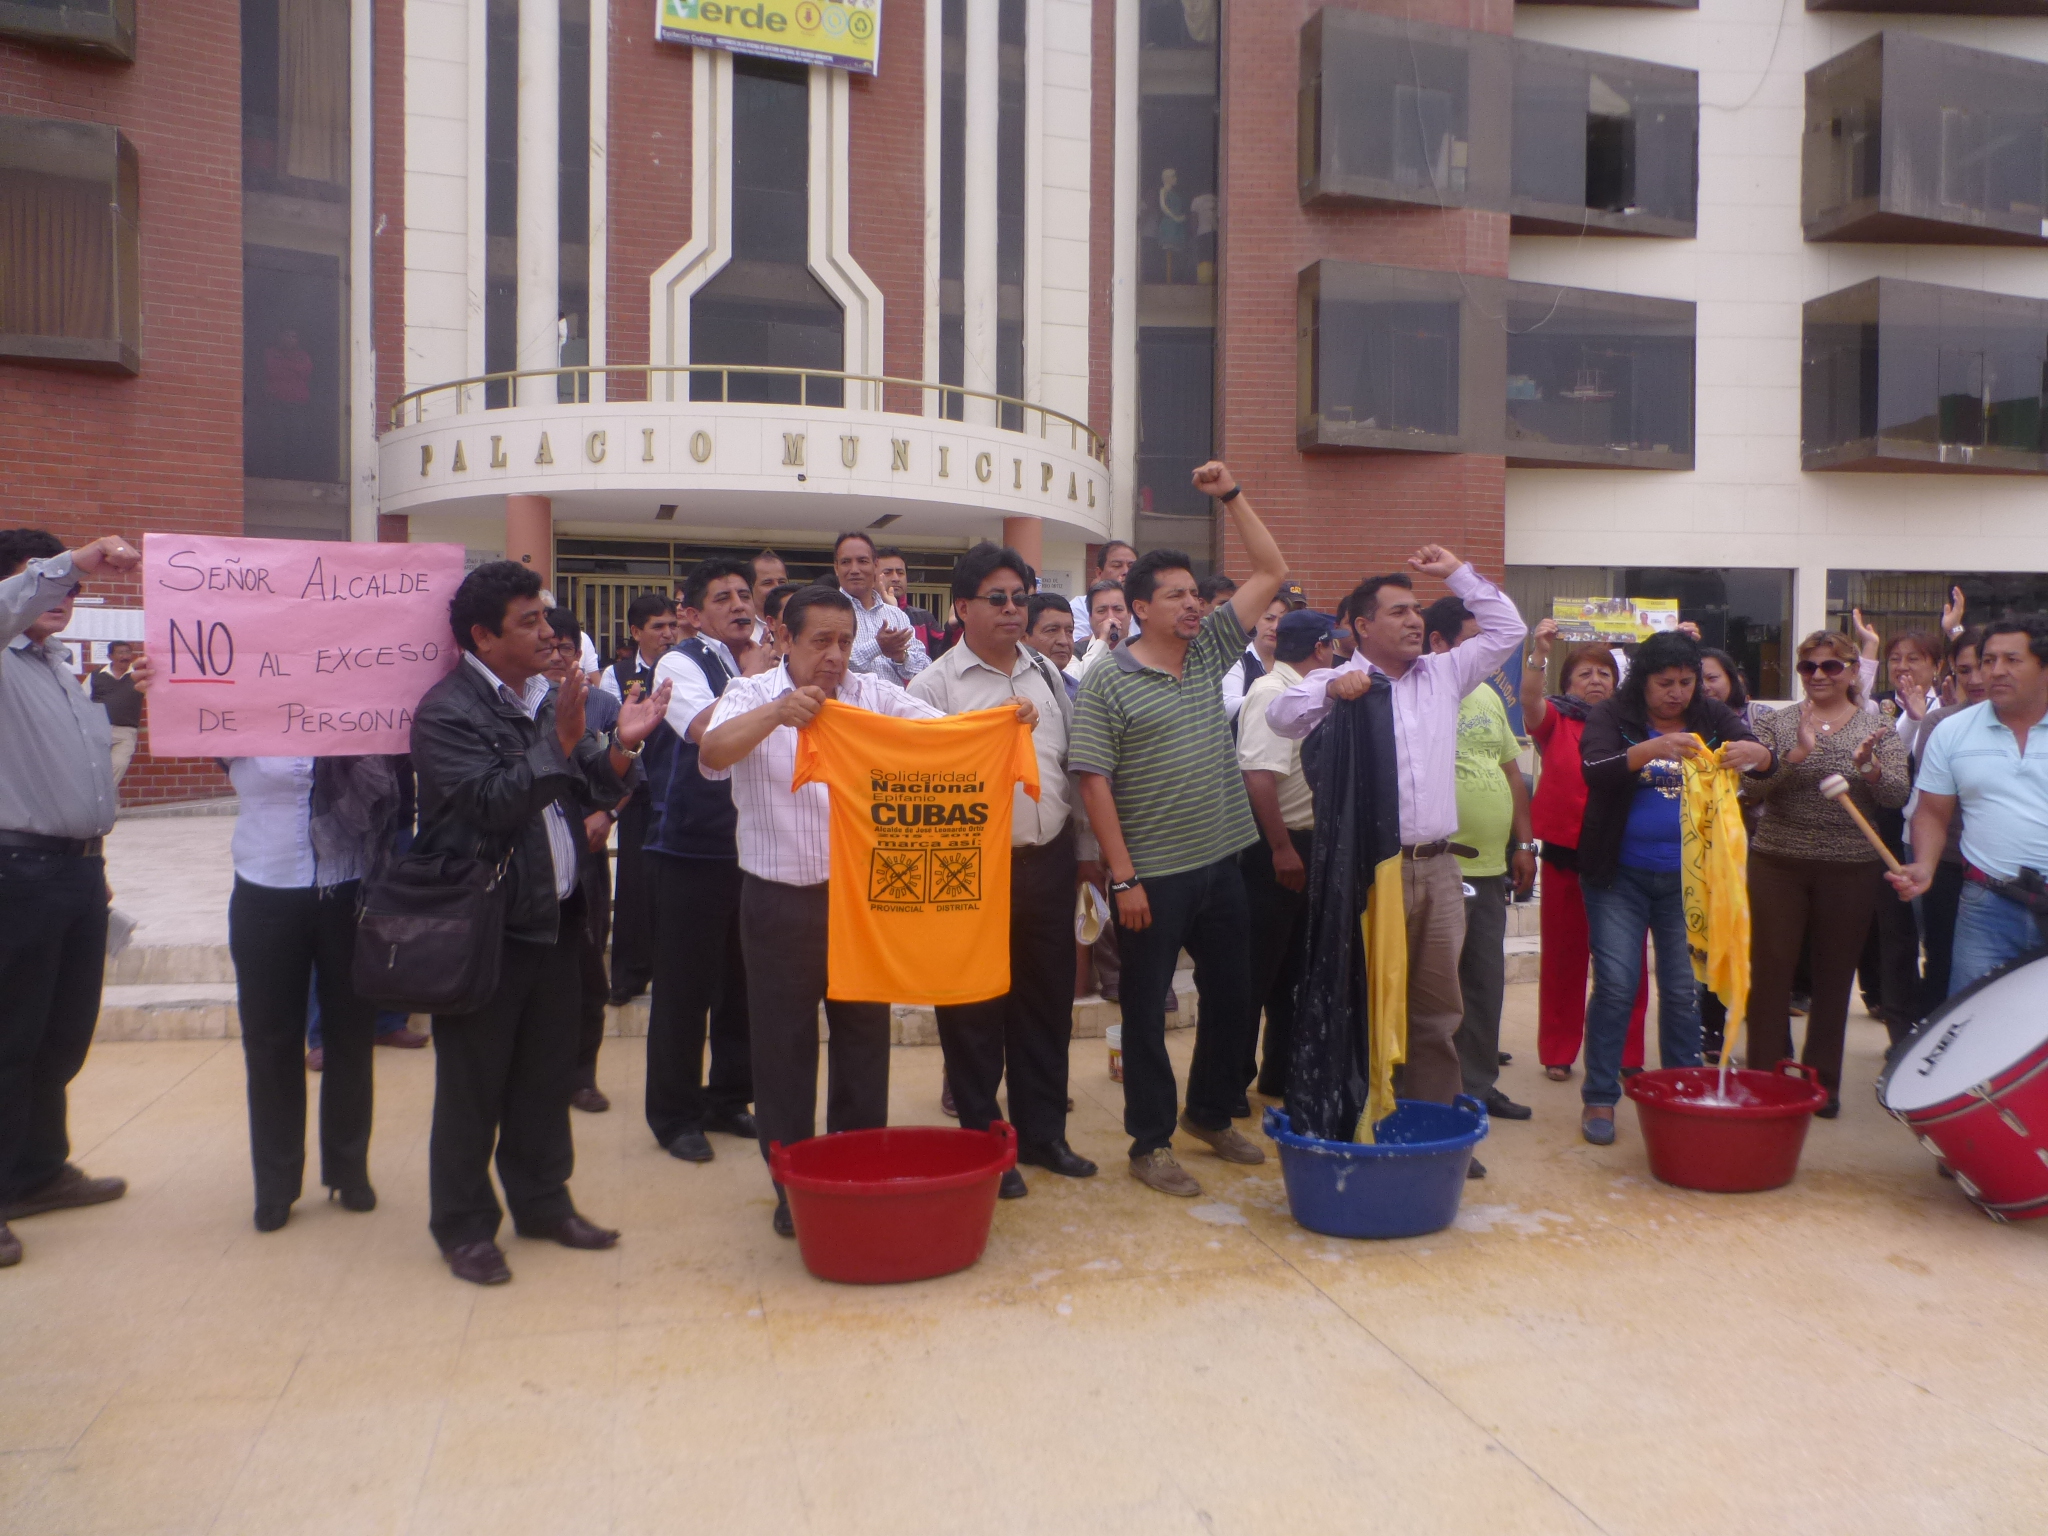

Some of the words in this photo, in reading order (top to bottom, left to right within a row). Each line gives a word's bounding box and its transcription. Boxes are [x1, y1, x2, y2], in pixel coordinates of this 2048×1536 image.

[420, 428, 713, 477] PALACIO
[782, 432, 1096, 508] MUNICIPAL
[159, 550, 276, 594] SEÑOR
[301, 556, 431, 602] ALCALDE
[169, 618, 235, 676] NO
[259, 651, 292, 678] AL
[315, 641, 440, 674] EXCESO
[1489, 667, 1517, 709] PALIDAD
[198, 707, 238, 734] DE
[277, 702, 414, 734] PERSONA
[869, 768, 978, 783] Solidaridad
[871, 780, 985, 794] Nacional
[872, 792, 937, 803] Epifanio
[870, 802, 989, 826] CUBAS
[874, 825, 902, 833] Alcalde
[904, 826, 914, 834] de
[915, 826, 932, 834] José
[968, 825, 985, 833] Ortiz
[877, 840, 942, 848] marca
[869, 903, 925, 913] PROVINCIAL
[936, 903, 981, 912] DISTRITAL
